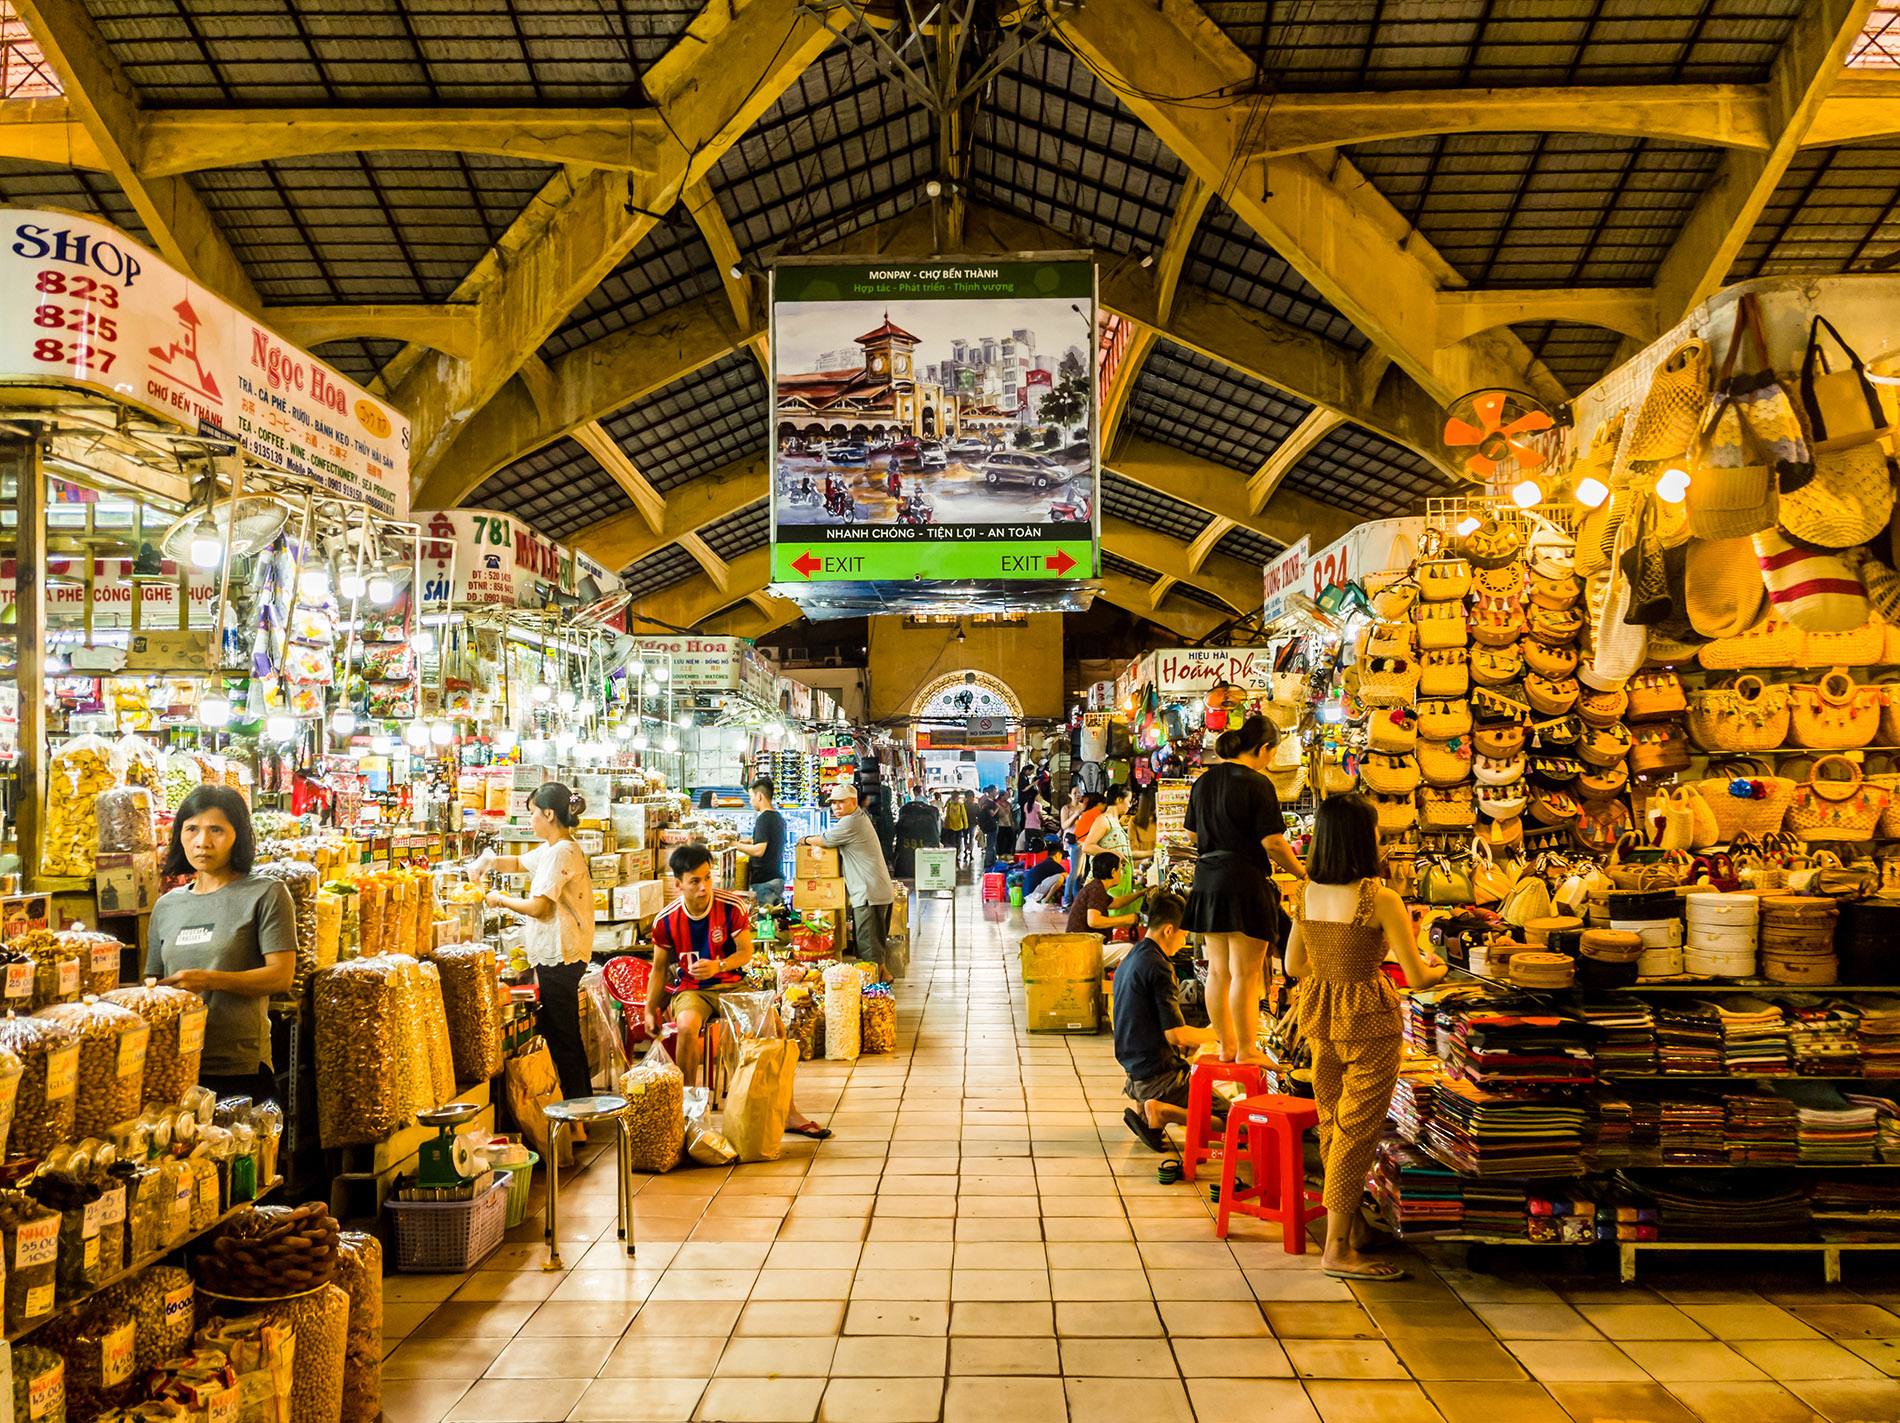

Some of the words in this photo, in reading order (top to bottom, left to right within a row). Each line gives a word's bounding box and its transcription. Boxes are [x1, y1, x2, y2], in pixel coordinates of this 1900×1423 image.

[12, 224, 141, 287] SHOP
[869, 270, 911, 279] MONPAY
[919, 268, 941, 280] CHỢ
[943, 267, 962, 279] BẾN
[964, 267, 998, 278] THÀNH
[35, 270, 119, 310] 823
[854, 283, 874, 294] Hợp
[876, 283, 891, 292] tác
[900, 283, 920, 292] Phát
[953, 282, 980, 293] Thịnh
[983, 283, 1014, 292] vượng
[33, 304, 117, 342] 825
[33, 338, 116, 373] 827
[251, 327, 304, 392] Ngọc
[310, 364, 348, 417] Hoa
[148, 379, 168, 402] CHỢ
[171, 388, 190, 414] BẾN
[193, 402, 222, 428] THÀNH
[238, 376, 252, 395] TRÀ
[258, 387, 269, 404] CÀ
[271, 395, 286, 413] PHÊ
[315, 419, 333, 439] BÁNH
[335, 430, 349, 447] KẸO
[269, 412, 296, 433] コーヒー
[238, 415, 251, 433] TEA
[258, 426, 284, 450] COFFEE
[290, 442, 305, 460] WINE
[311, 453, 358, 485] CONFECTIONERY
[362, 478, 372, 492] SEA
[373, 485, 396, 504] PRODUCT
[254, 441, 282, 465] 9135139
[287, 457, 305, 474] Mobile
[306, 467, 324, 485] Phone
[327, 477, 341, 492] 0903
[473, 516, 511, 548] 781
[826, 528, 868, 539] NHANH
[872, 526, 915, 538] CHÓNG
[927, 526, 954, 540] TIỆN
[956, 526, 976, 540] LỢI
[988, 528, 1005, 538] AN
[1008, 525, 1041, 538] TOÀN
[825, 557, 865, 572] EXIT
[1001, 556, 1042, 571] EXIT
[472, 570, 482, 579] ĐT
[488, 570, 499, 580] 520
[468, 581, 488, 590] ĐTNR
[493, 582, 504, 592] 856
[57, 585, 84, 602] PHÊ
[93, 584, 131, 602] CÔNG
[178, 584, 214, 605] HỰC
[466, 592, 477, 601] DĐ
[685, 640, 727, 653] Hoa
[1213, 649, 1228, 660] HÀI
[392, 837, 409, 846] COFFEE
[410, 837, 426, 847] COFFEE
[904, 838, 924, 849] 591
